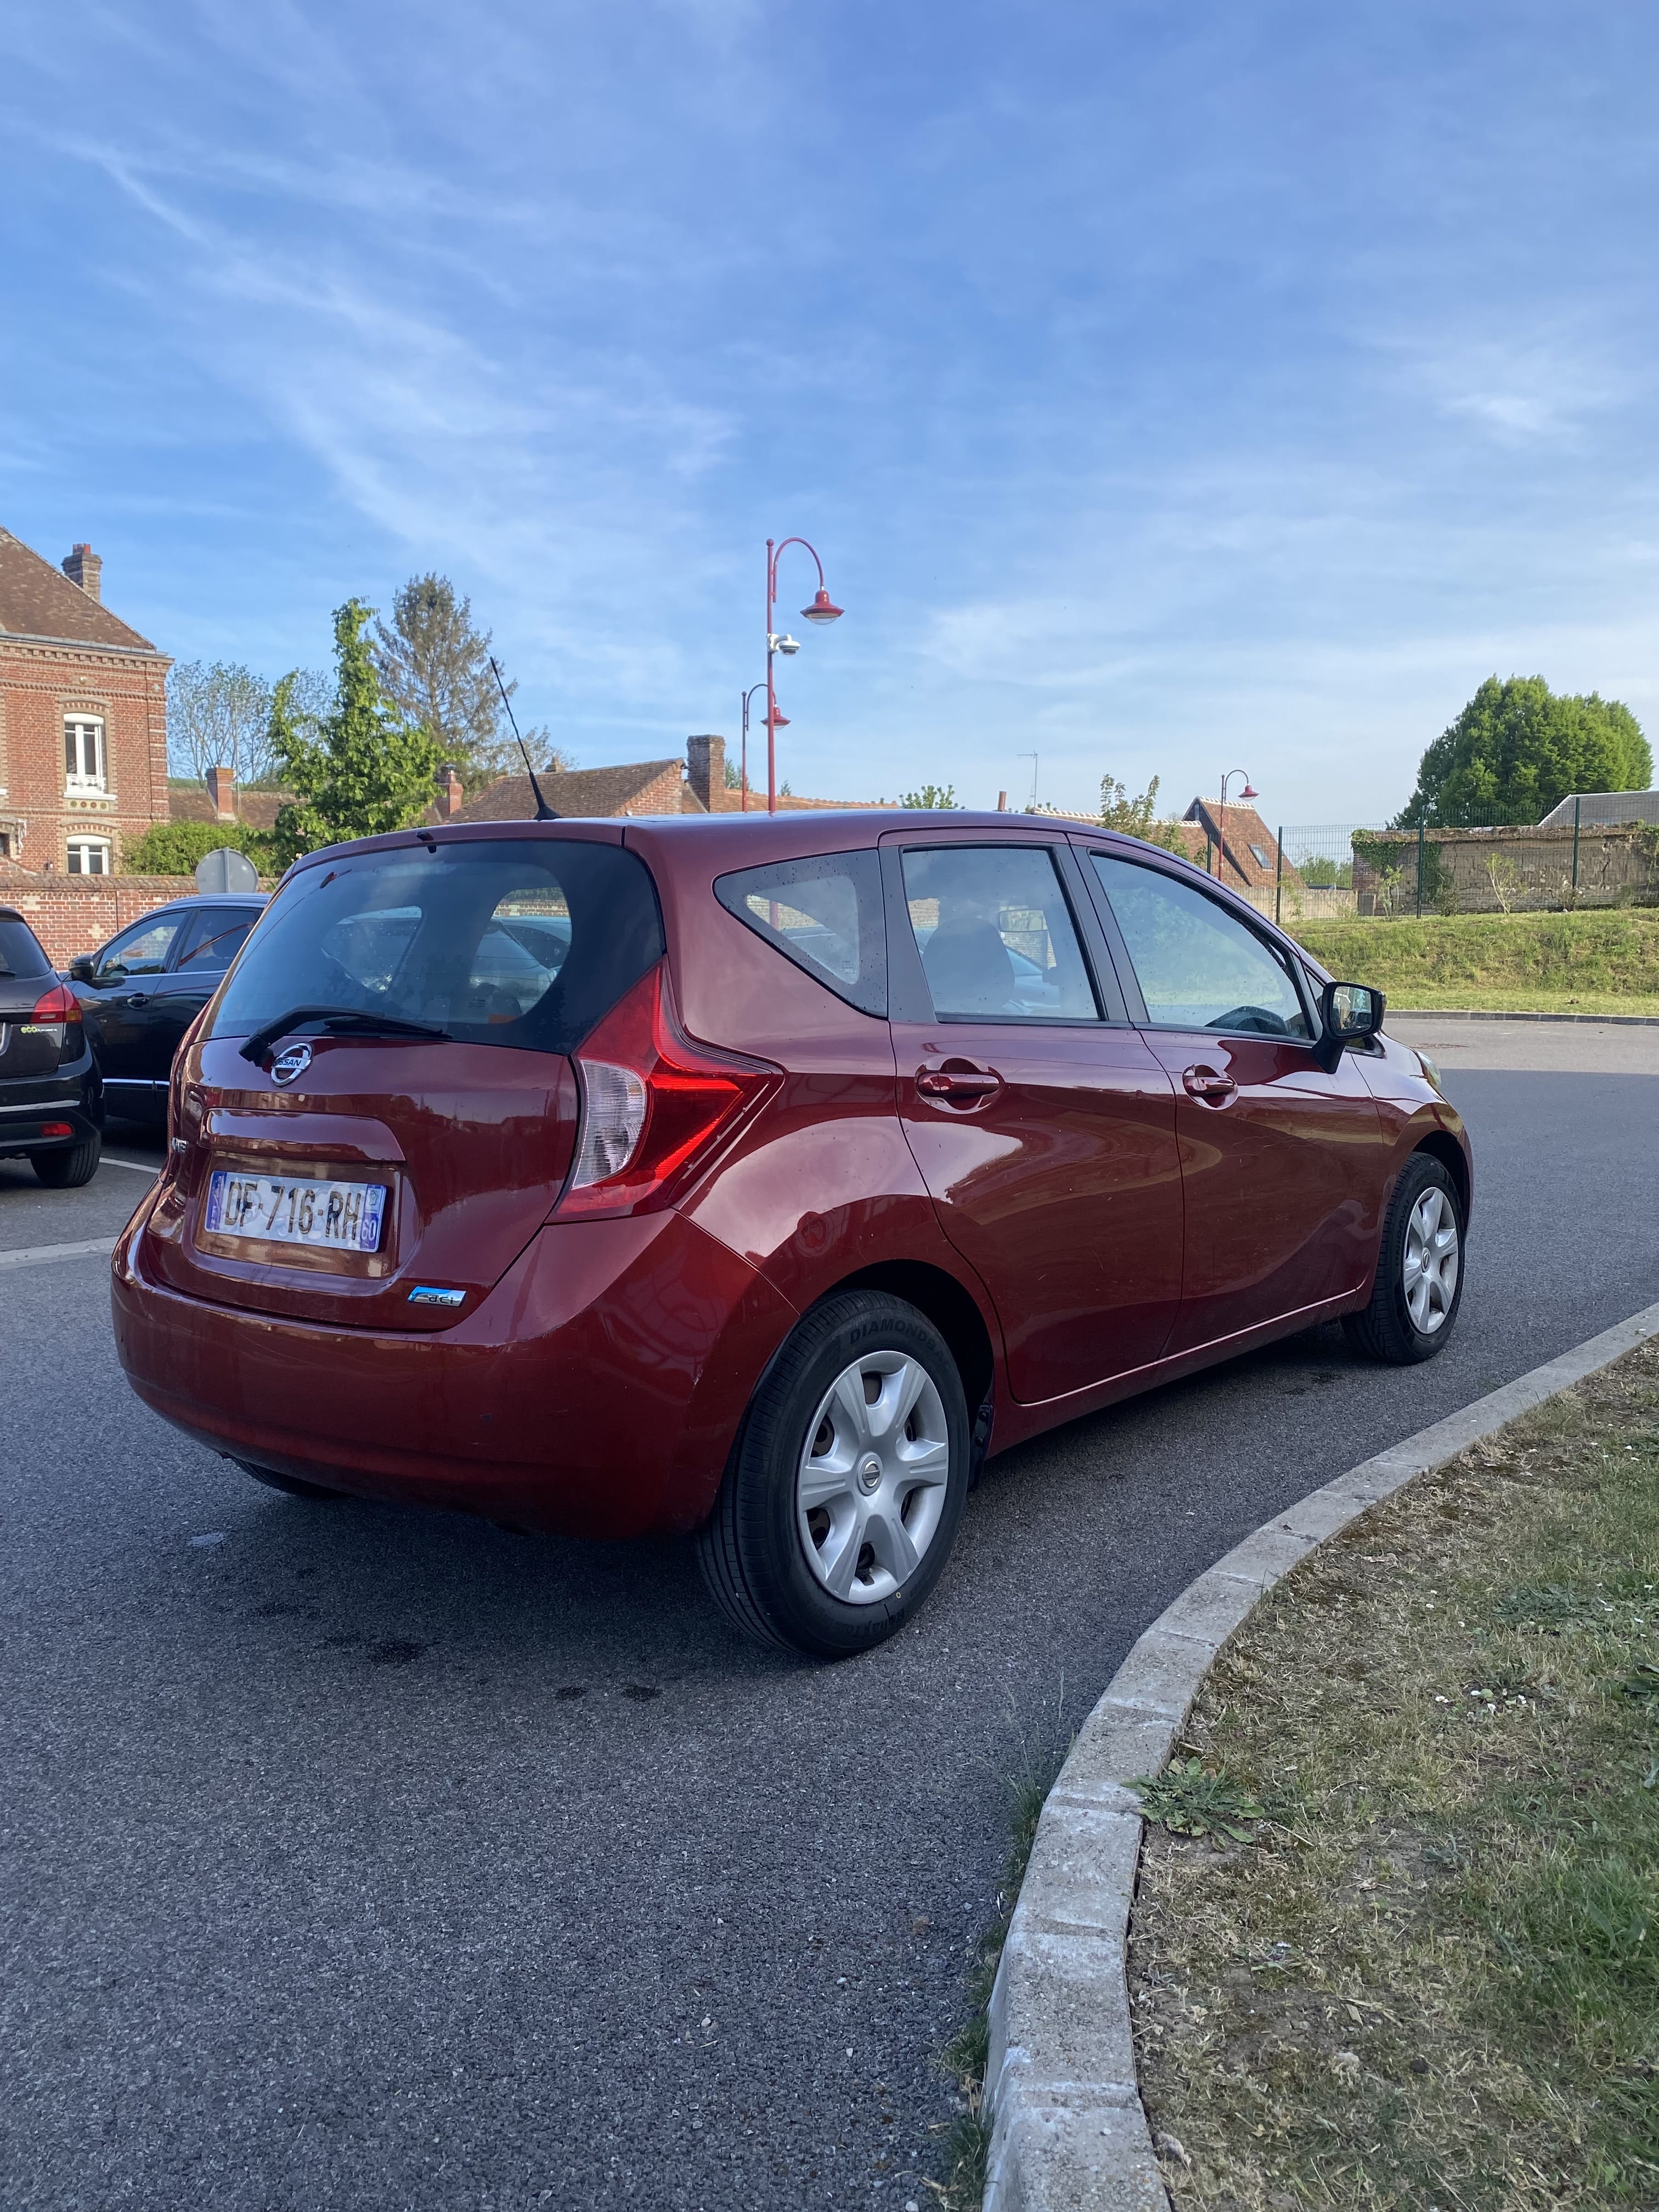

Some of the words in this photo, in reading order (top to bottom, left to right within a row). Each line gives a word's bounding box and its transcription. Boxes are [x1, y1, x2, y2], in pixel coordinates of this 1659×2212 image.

[224, 1181, 362, 1240] DF-716-RH
[361, 1219, 377, 1241] 60
[850, 1318, 949, 1369] DIAMONDBA
